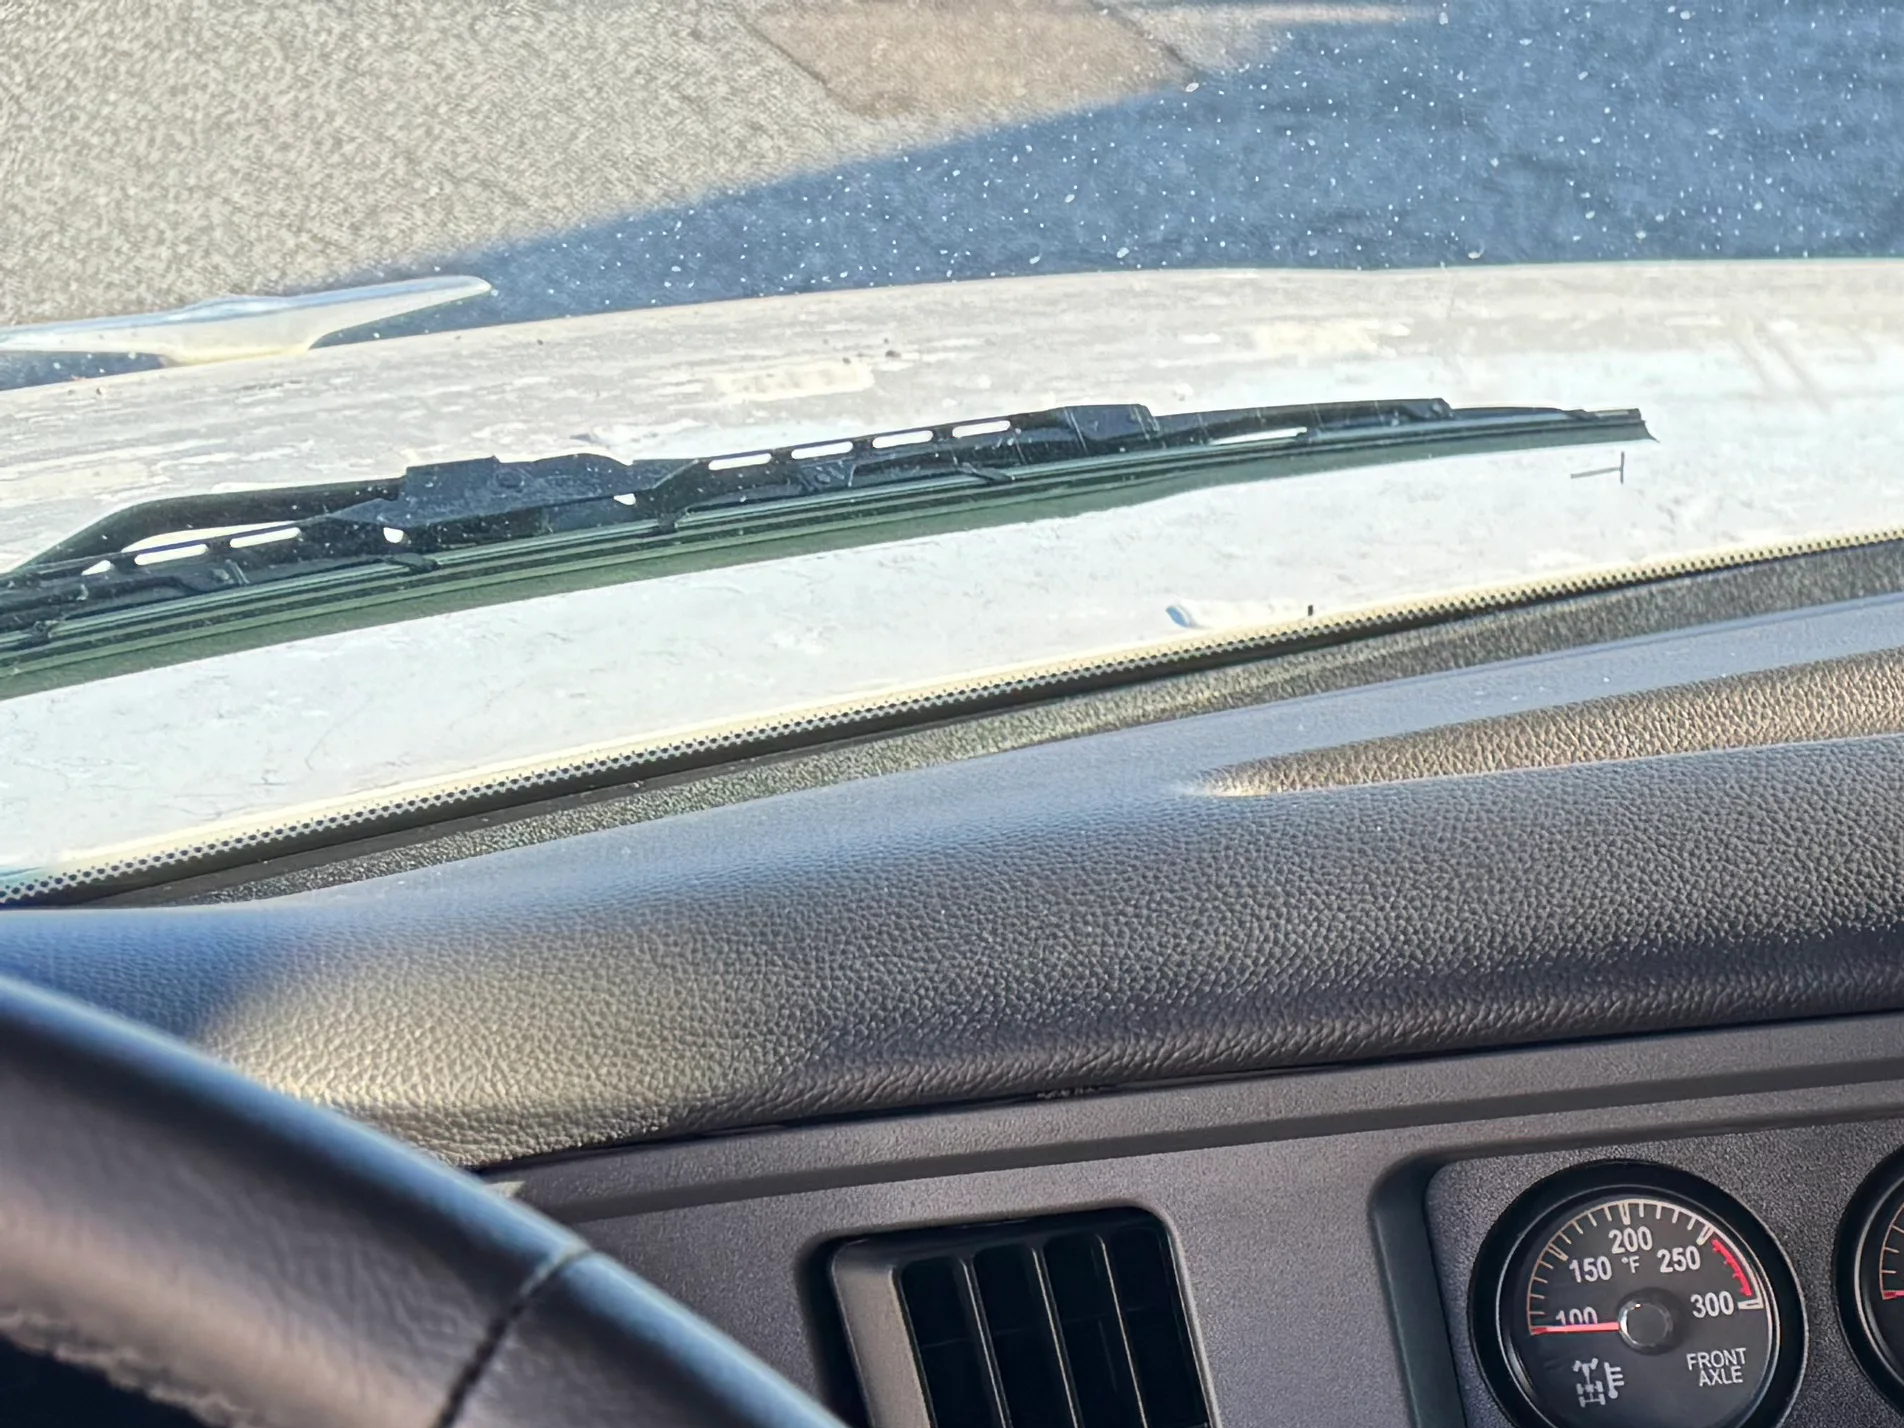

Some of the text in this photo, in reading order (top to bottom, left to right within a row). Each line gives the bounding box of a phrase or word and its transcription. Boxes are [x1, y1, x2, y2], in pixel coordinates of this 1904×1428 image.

[1608, 1226, 1653, 1254] 200
[1569, 1256, 1612, 1282] 150
[1657, 1246, 1700, 1273] 250
[1690, 1291, 1734, 1318] 300
[1686, 1348, 1746, 1371] FRONT
[1699, 1365, 1743, 1387] AXLE
